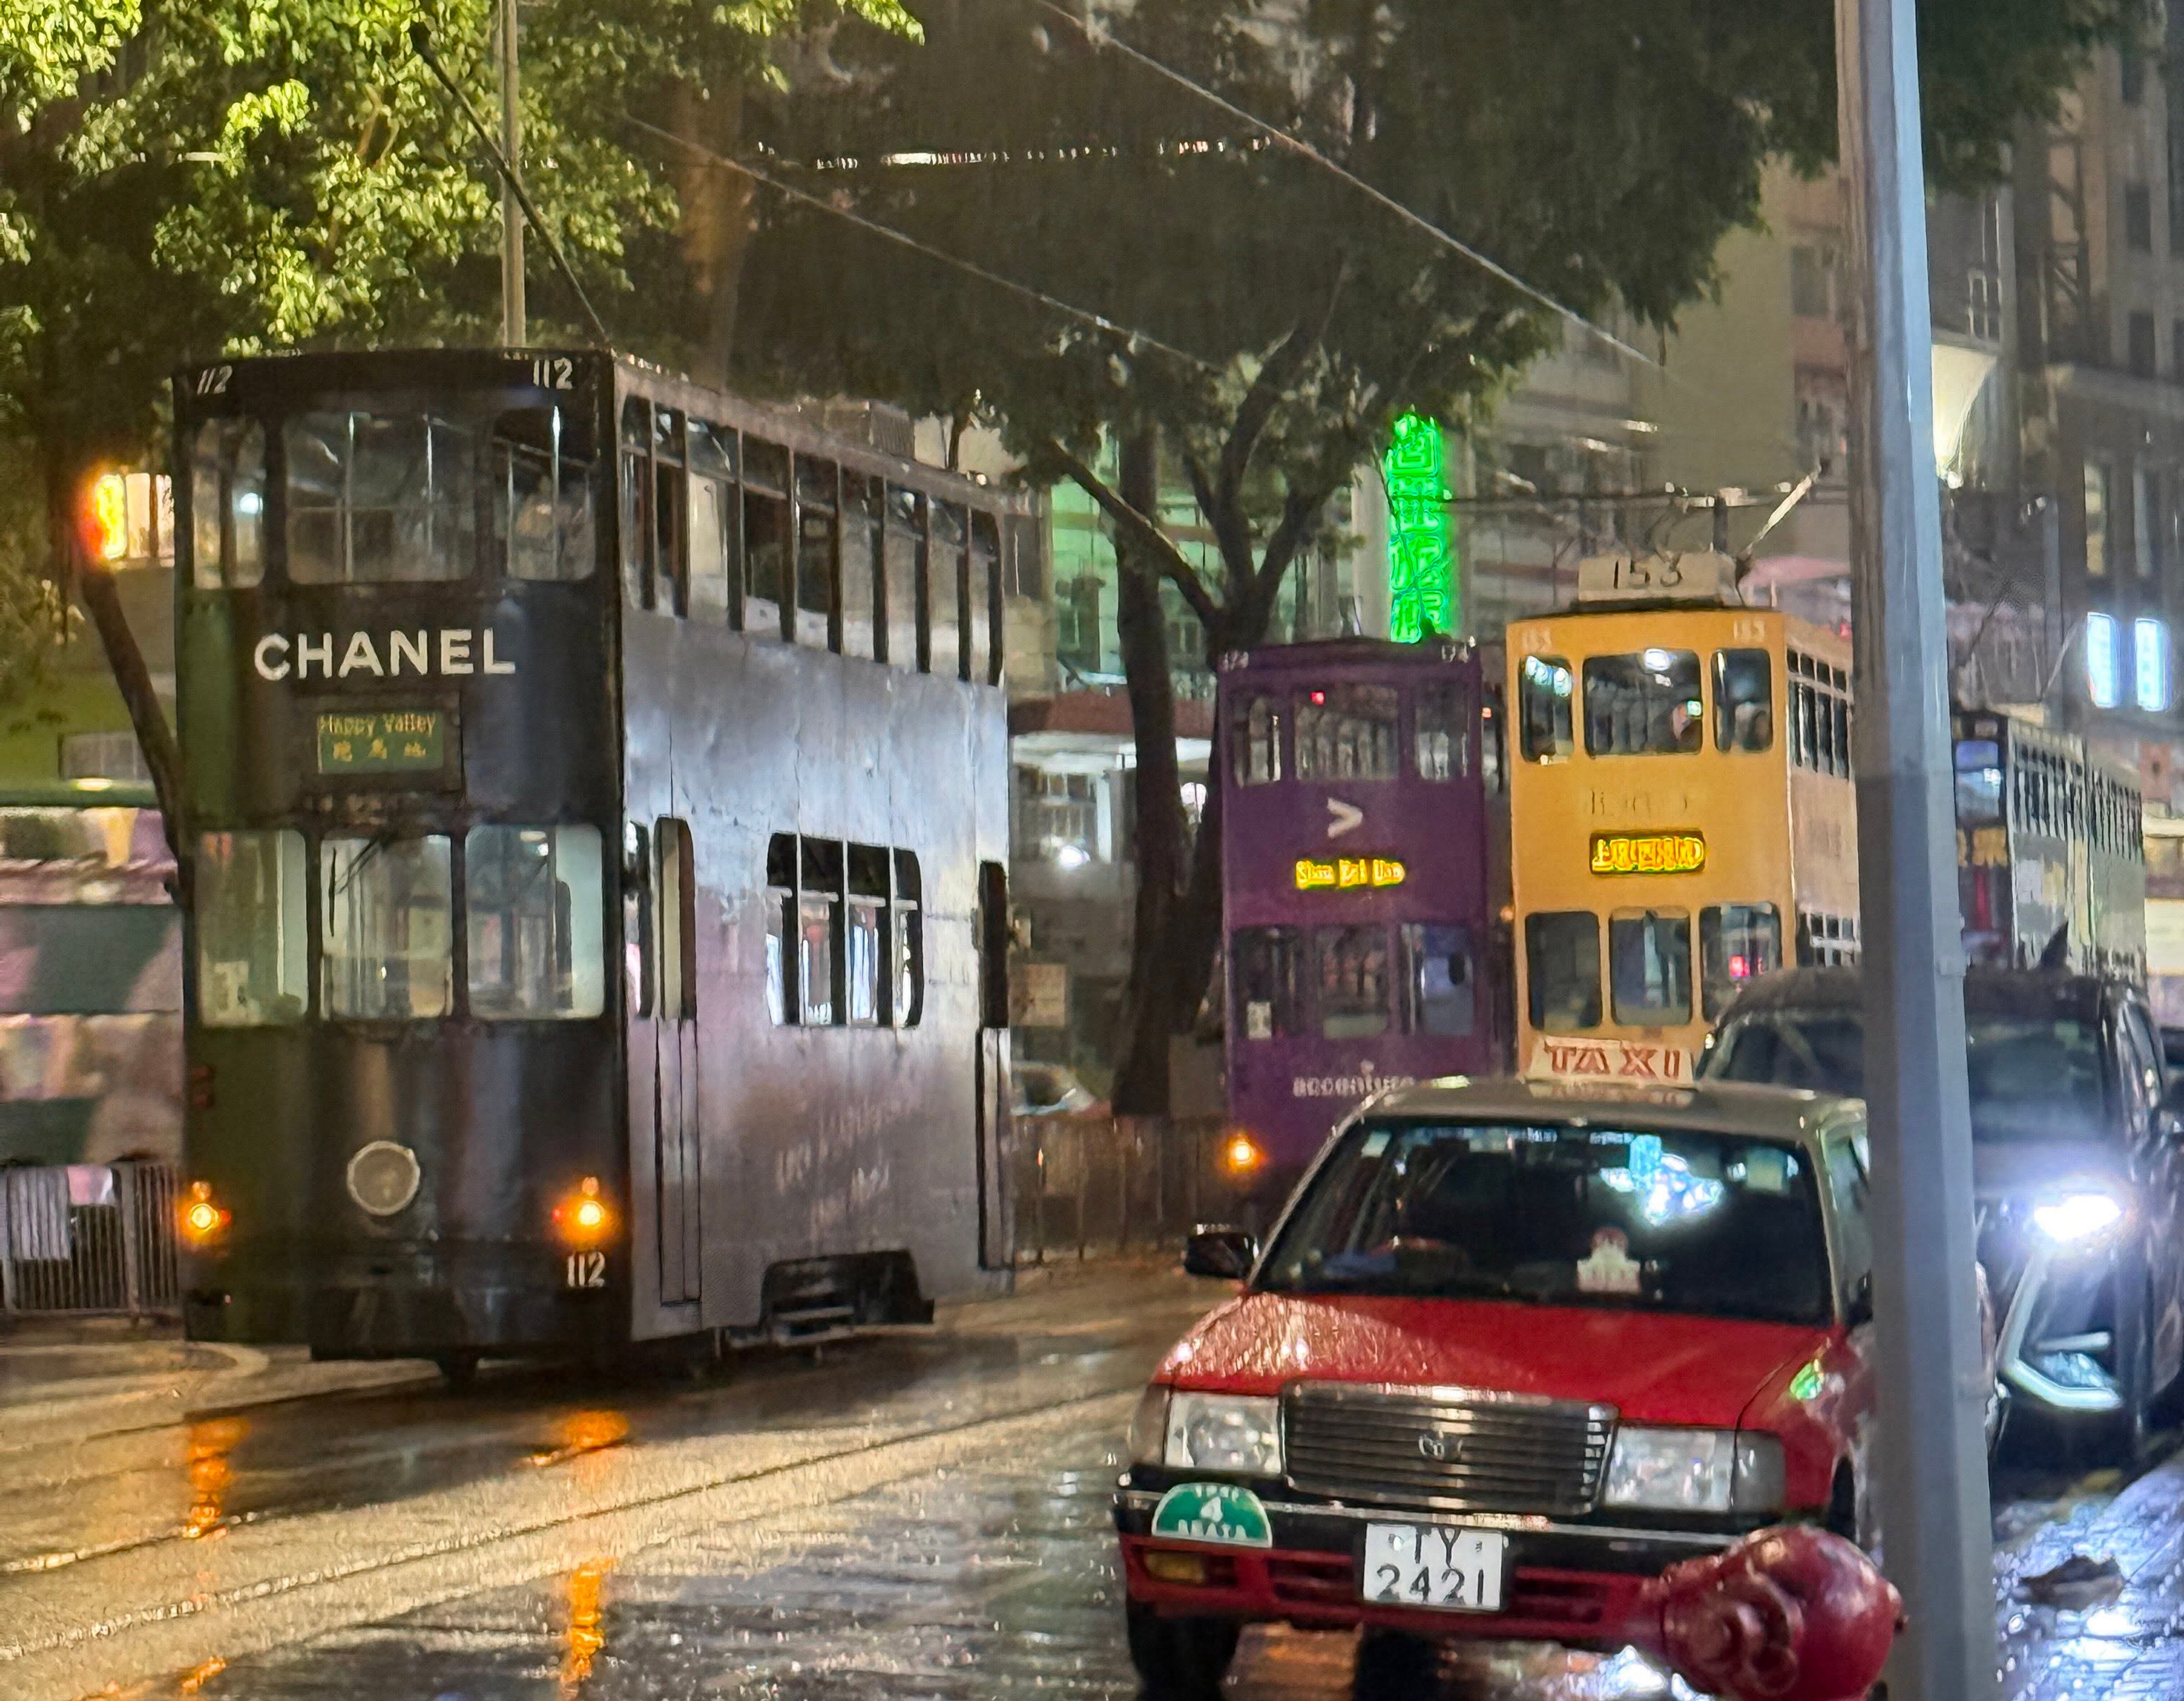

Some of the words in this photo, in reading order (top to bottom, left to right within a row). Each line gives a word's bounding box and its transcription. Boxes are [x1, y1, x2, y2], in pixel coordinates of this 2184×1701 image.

[197, 365, 233, 395] 112
[533, 357, 573, 390] 112
[1613, 559, 1683, 588] 153
[254, 628, 516, 681] CHANEL
[382, 713, 436, 737] Valley
[1543, 1044, 1680, 1080] TAXI
[567, 1251, 605, 1287] 112
[1376, 1561, 1485, 1605] 2421
